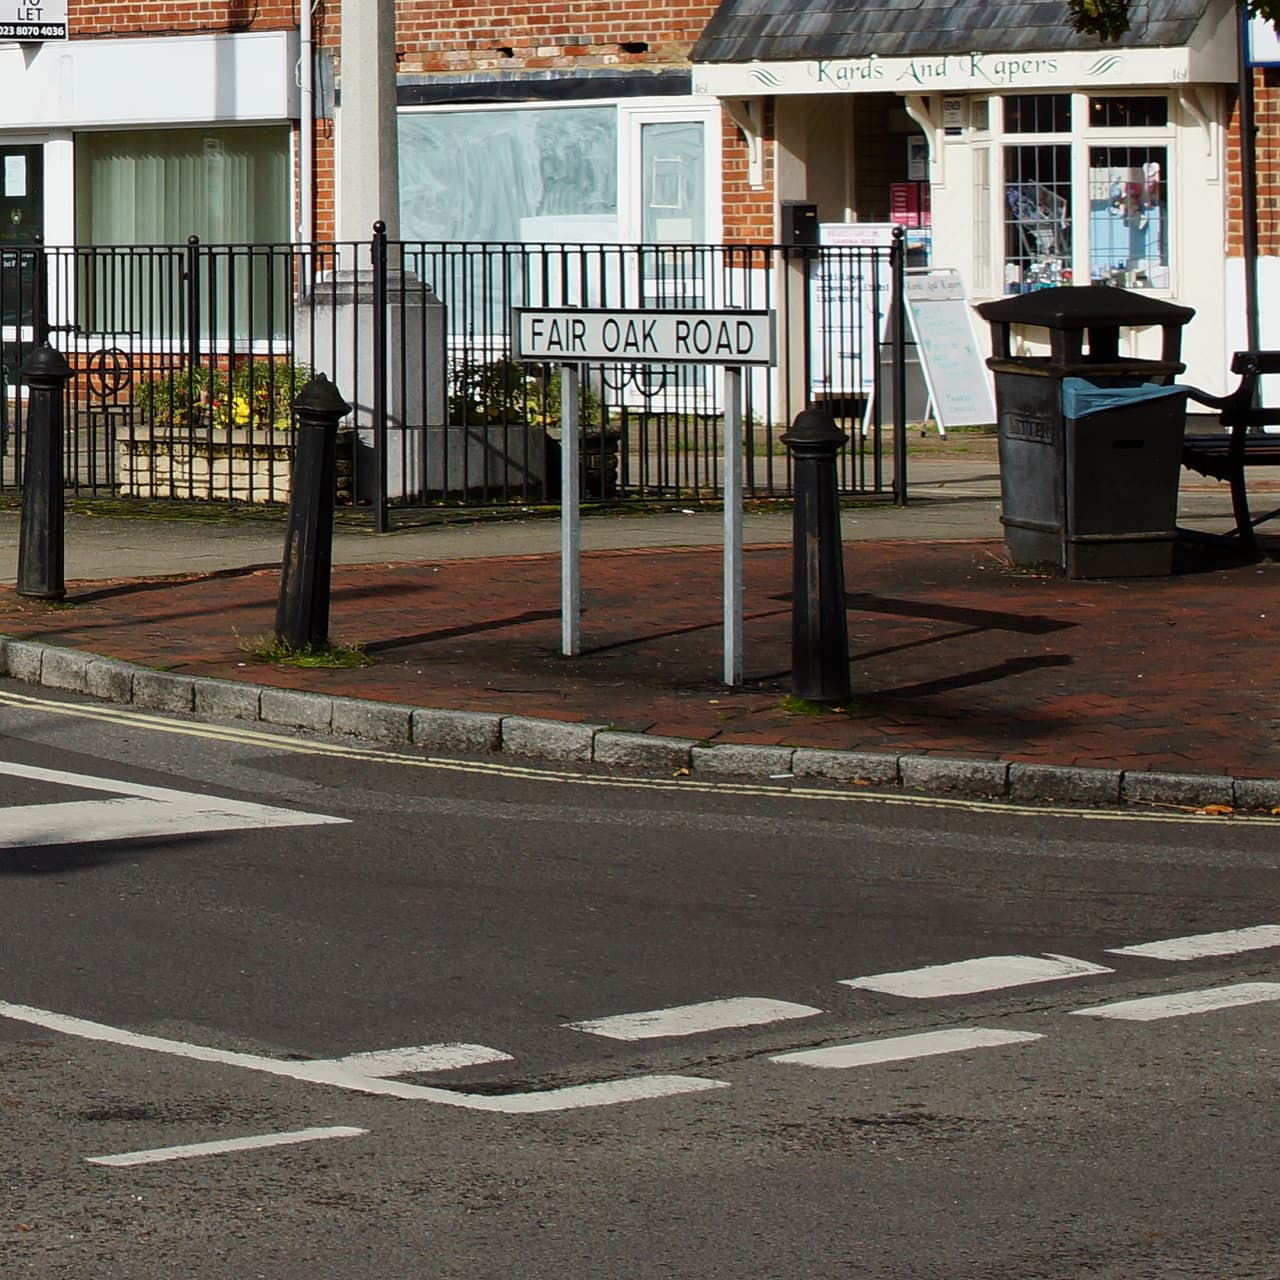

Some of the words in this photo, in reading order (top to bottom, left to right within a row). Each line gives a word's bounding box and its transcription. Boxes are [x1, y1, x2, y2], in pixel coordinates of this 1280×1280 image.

[17, 7, 44, 21] LET
[16, 26, 40, 36] 8070
[40, 26, 65, 36] 4036
[807, 57, 884, 91] Kards
[896, 54, 948, 85] And
[959, 53, 1058, 86] Kapers
[530, 319, 588, 353] FAIR
[602, 318, 658, 354] OAK
[675, 320, 754, 355] ROAD
